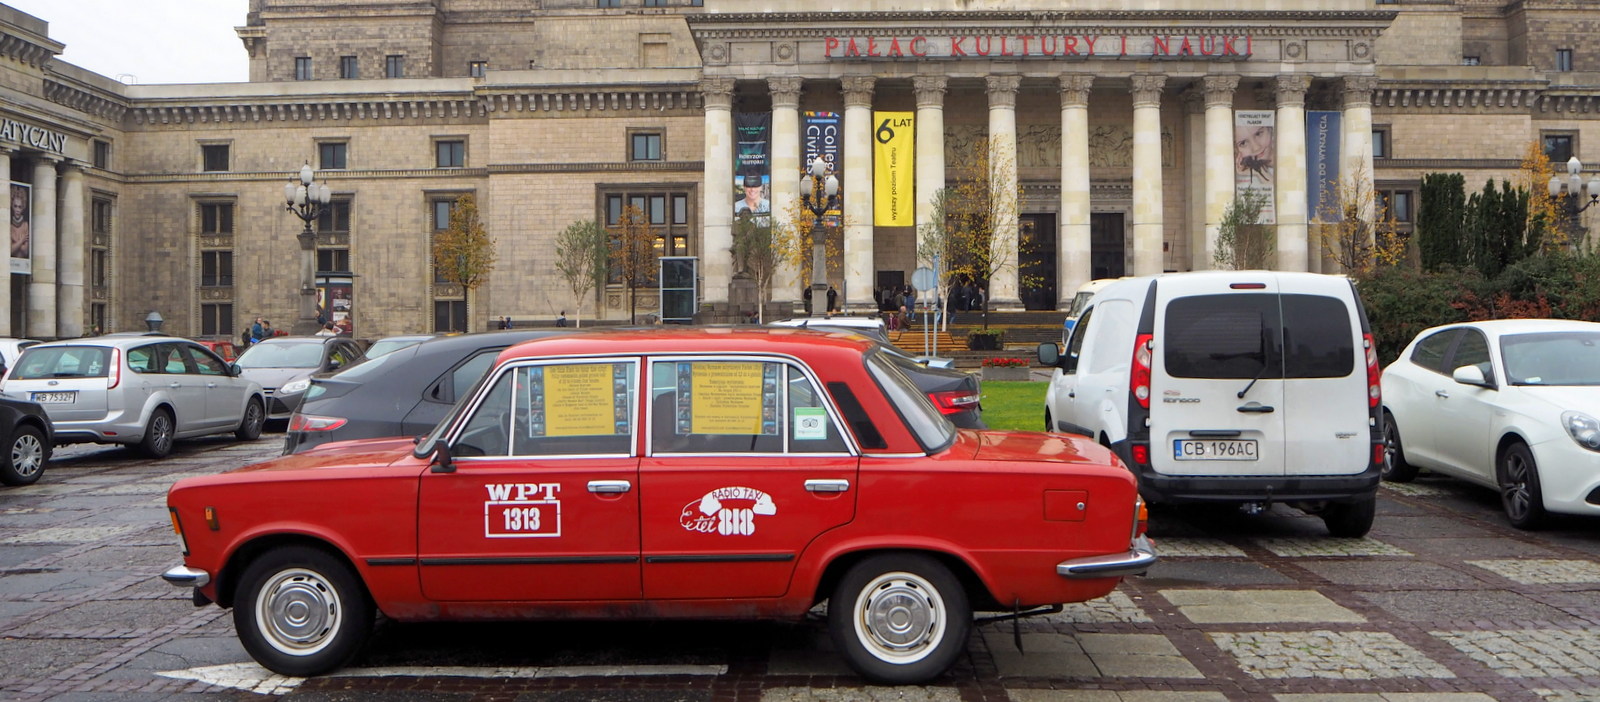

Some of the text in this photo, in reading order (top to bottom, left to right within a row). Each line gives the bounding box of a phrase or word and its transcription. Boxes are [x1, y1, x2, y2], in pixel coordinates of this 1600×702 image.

[824, 36, 927, 57] PAŁAC
[950, 36, 1099, 56] KULTURY
[1120, 36, 1127, 56] I
[1153, 35, 1253, 56] NAUKI
[876, 118, 912, 144] 6 LAT
[1318, 163, 1327, 176] DO
[1184, 442, 1205, 456] CB
[1211, 442, 1254, 456] 196AC
[485, 483, 560, 501] WPT
[712, 488, 764, 500] RADIO TAXI
[503, 507, 540, 531] 1313
[718, 508, 755, 536] 818
